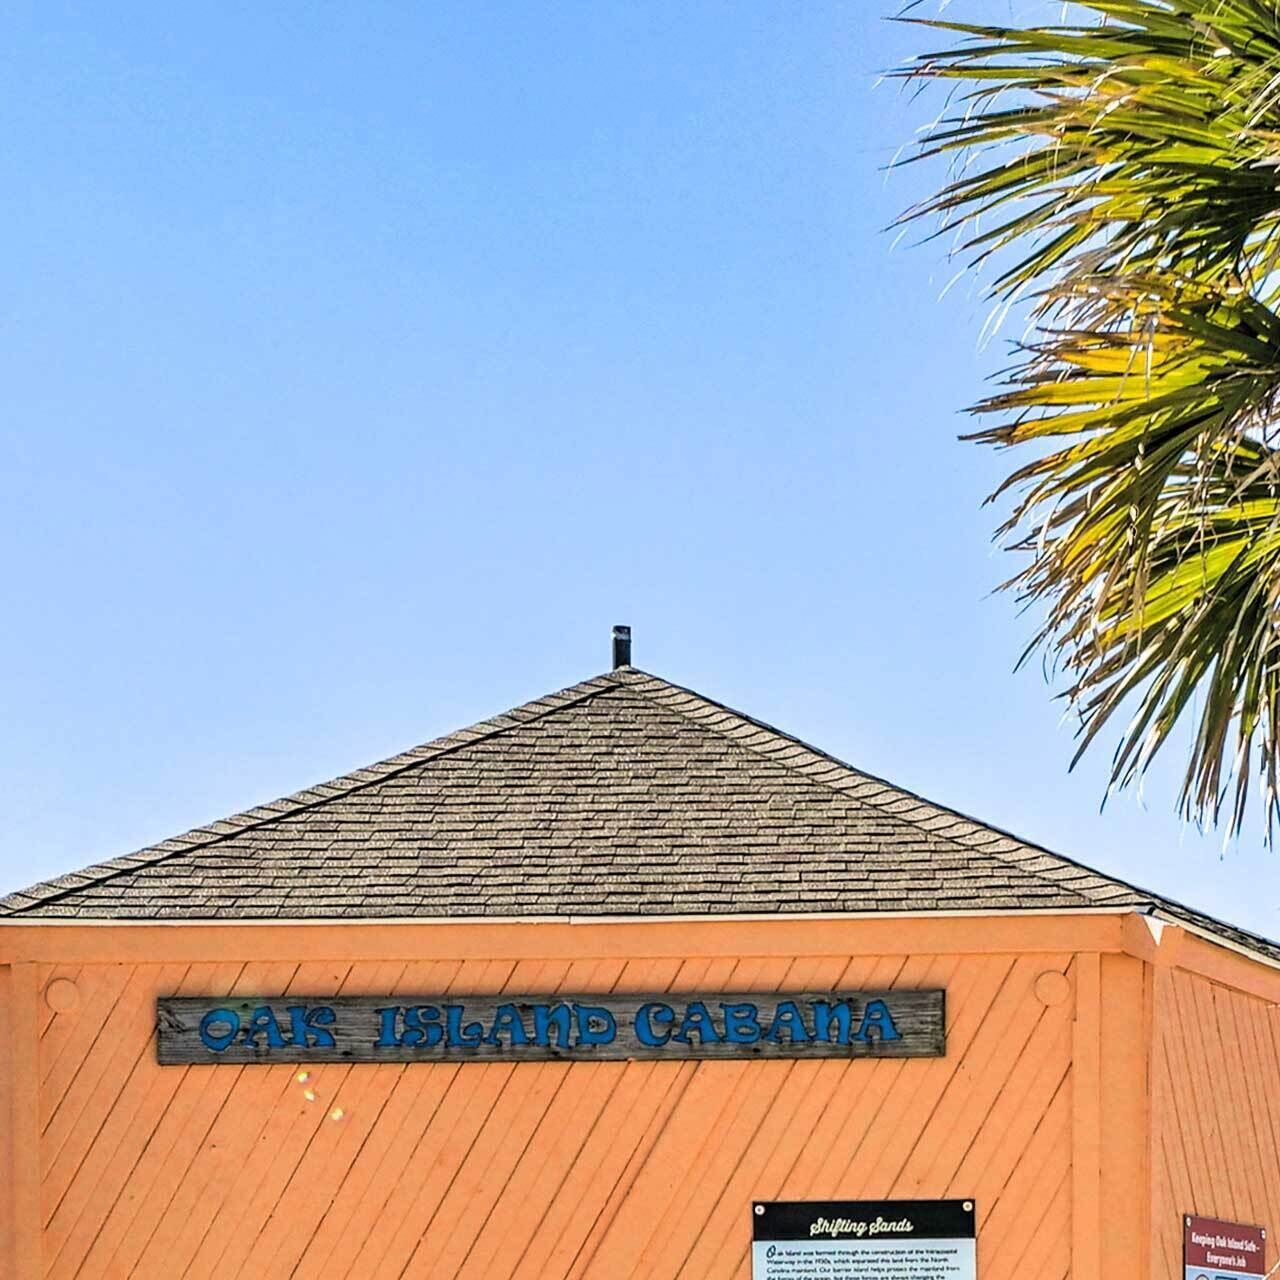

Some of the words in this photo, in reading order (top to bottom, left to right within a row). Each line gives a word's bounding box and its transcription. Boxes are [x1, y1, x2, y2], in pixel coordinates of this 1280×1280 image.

[199, 1006, 336, 1051] OAK
[374, 1003, 617, 1049] ISLAND
[634, 1000, 902, 1046] CABANA
[810, 1217, 867, 1237] Shifting
[869, 1217, 914, 1236] Sands
[1191, 1232, 1215, 1249] Keeping
[1216, 1235, 1226, 1248] Oak
[1227, 1237, 1244, 1250] Island
